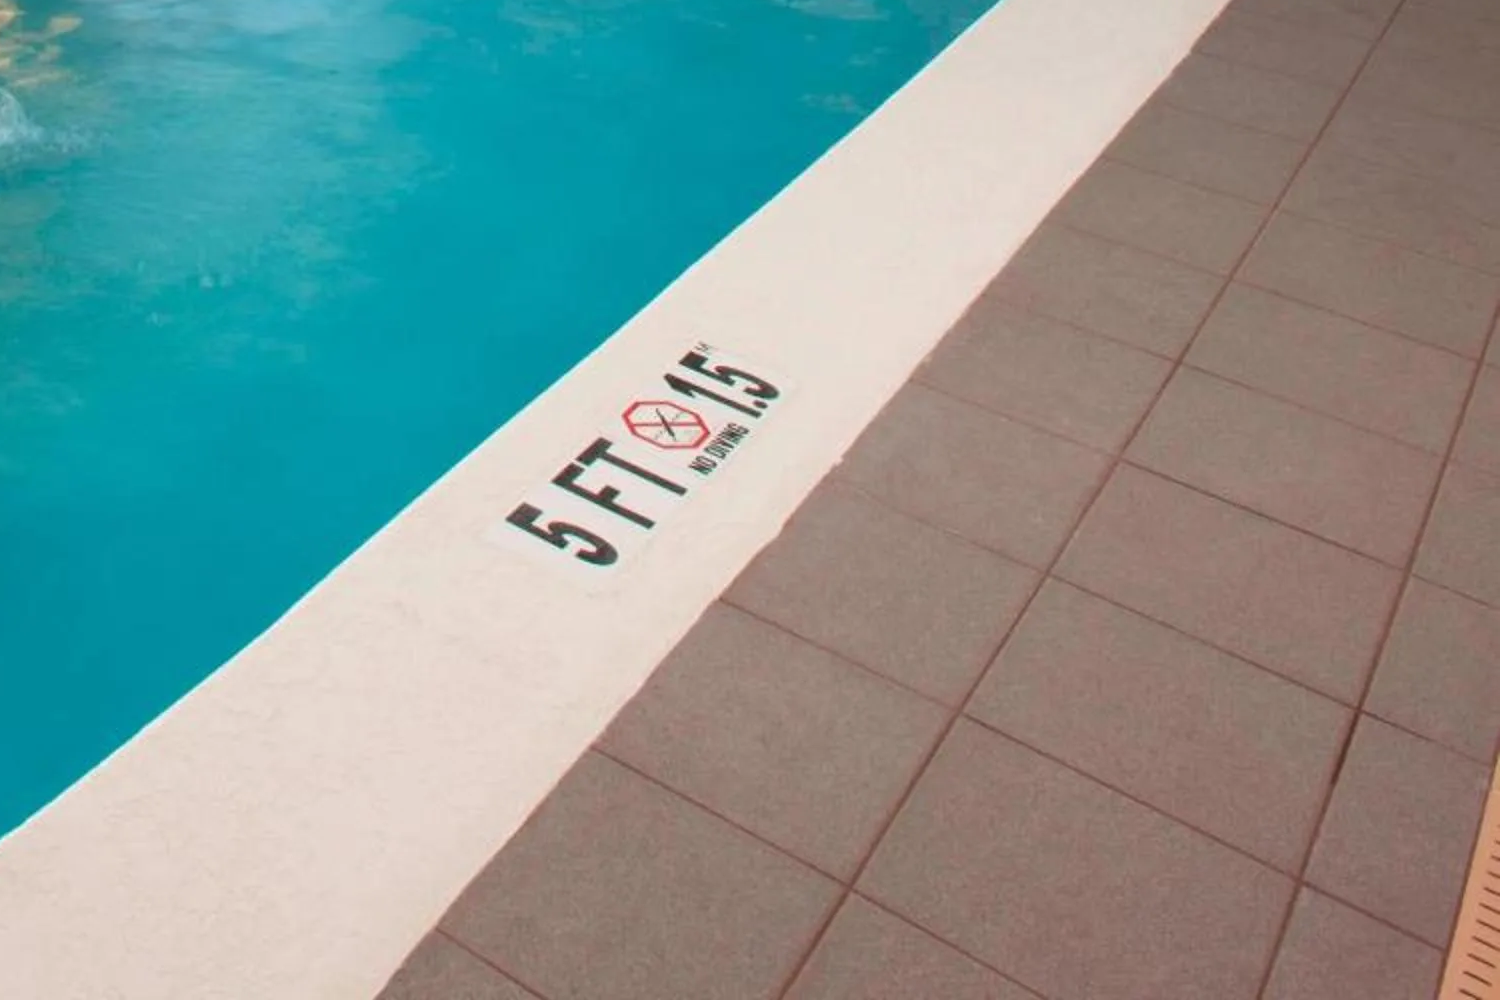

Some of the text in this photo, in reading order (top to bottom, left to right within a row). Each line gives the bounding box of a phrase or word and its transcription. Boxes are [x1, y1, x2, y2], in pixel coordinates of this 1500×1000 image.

[663, 350, 780, 419] 1.5
[688, 421, 750, 476] NO DIVING
[551, 436, 688, 530] FT
[505, 502, 619, 566] 5
